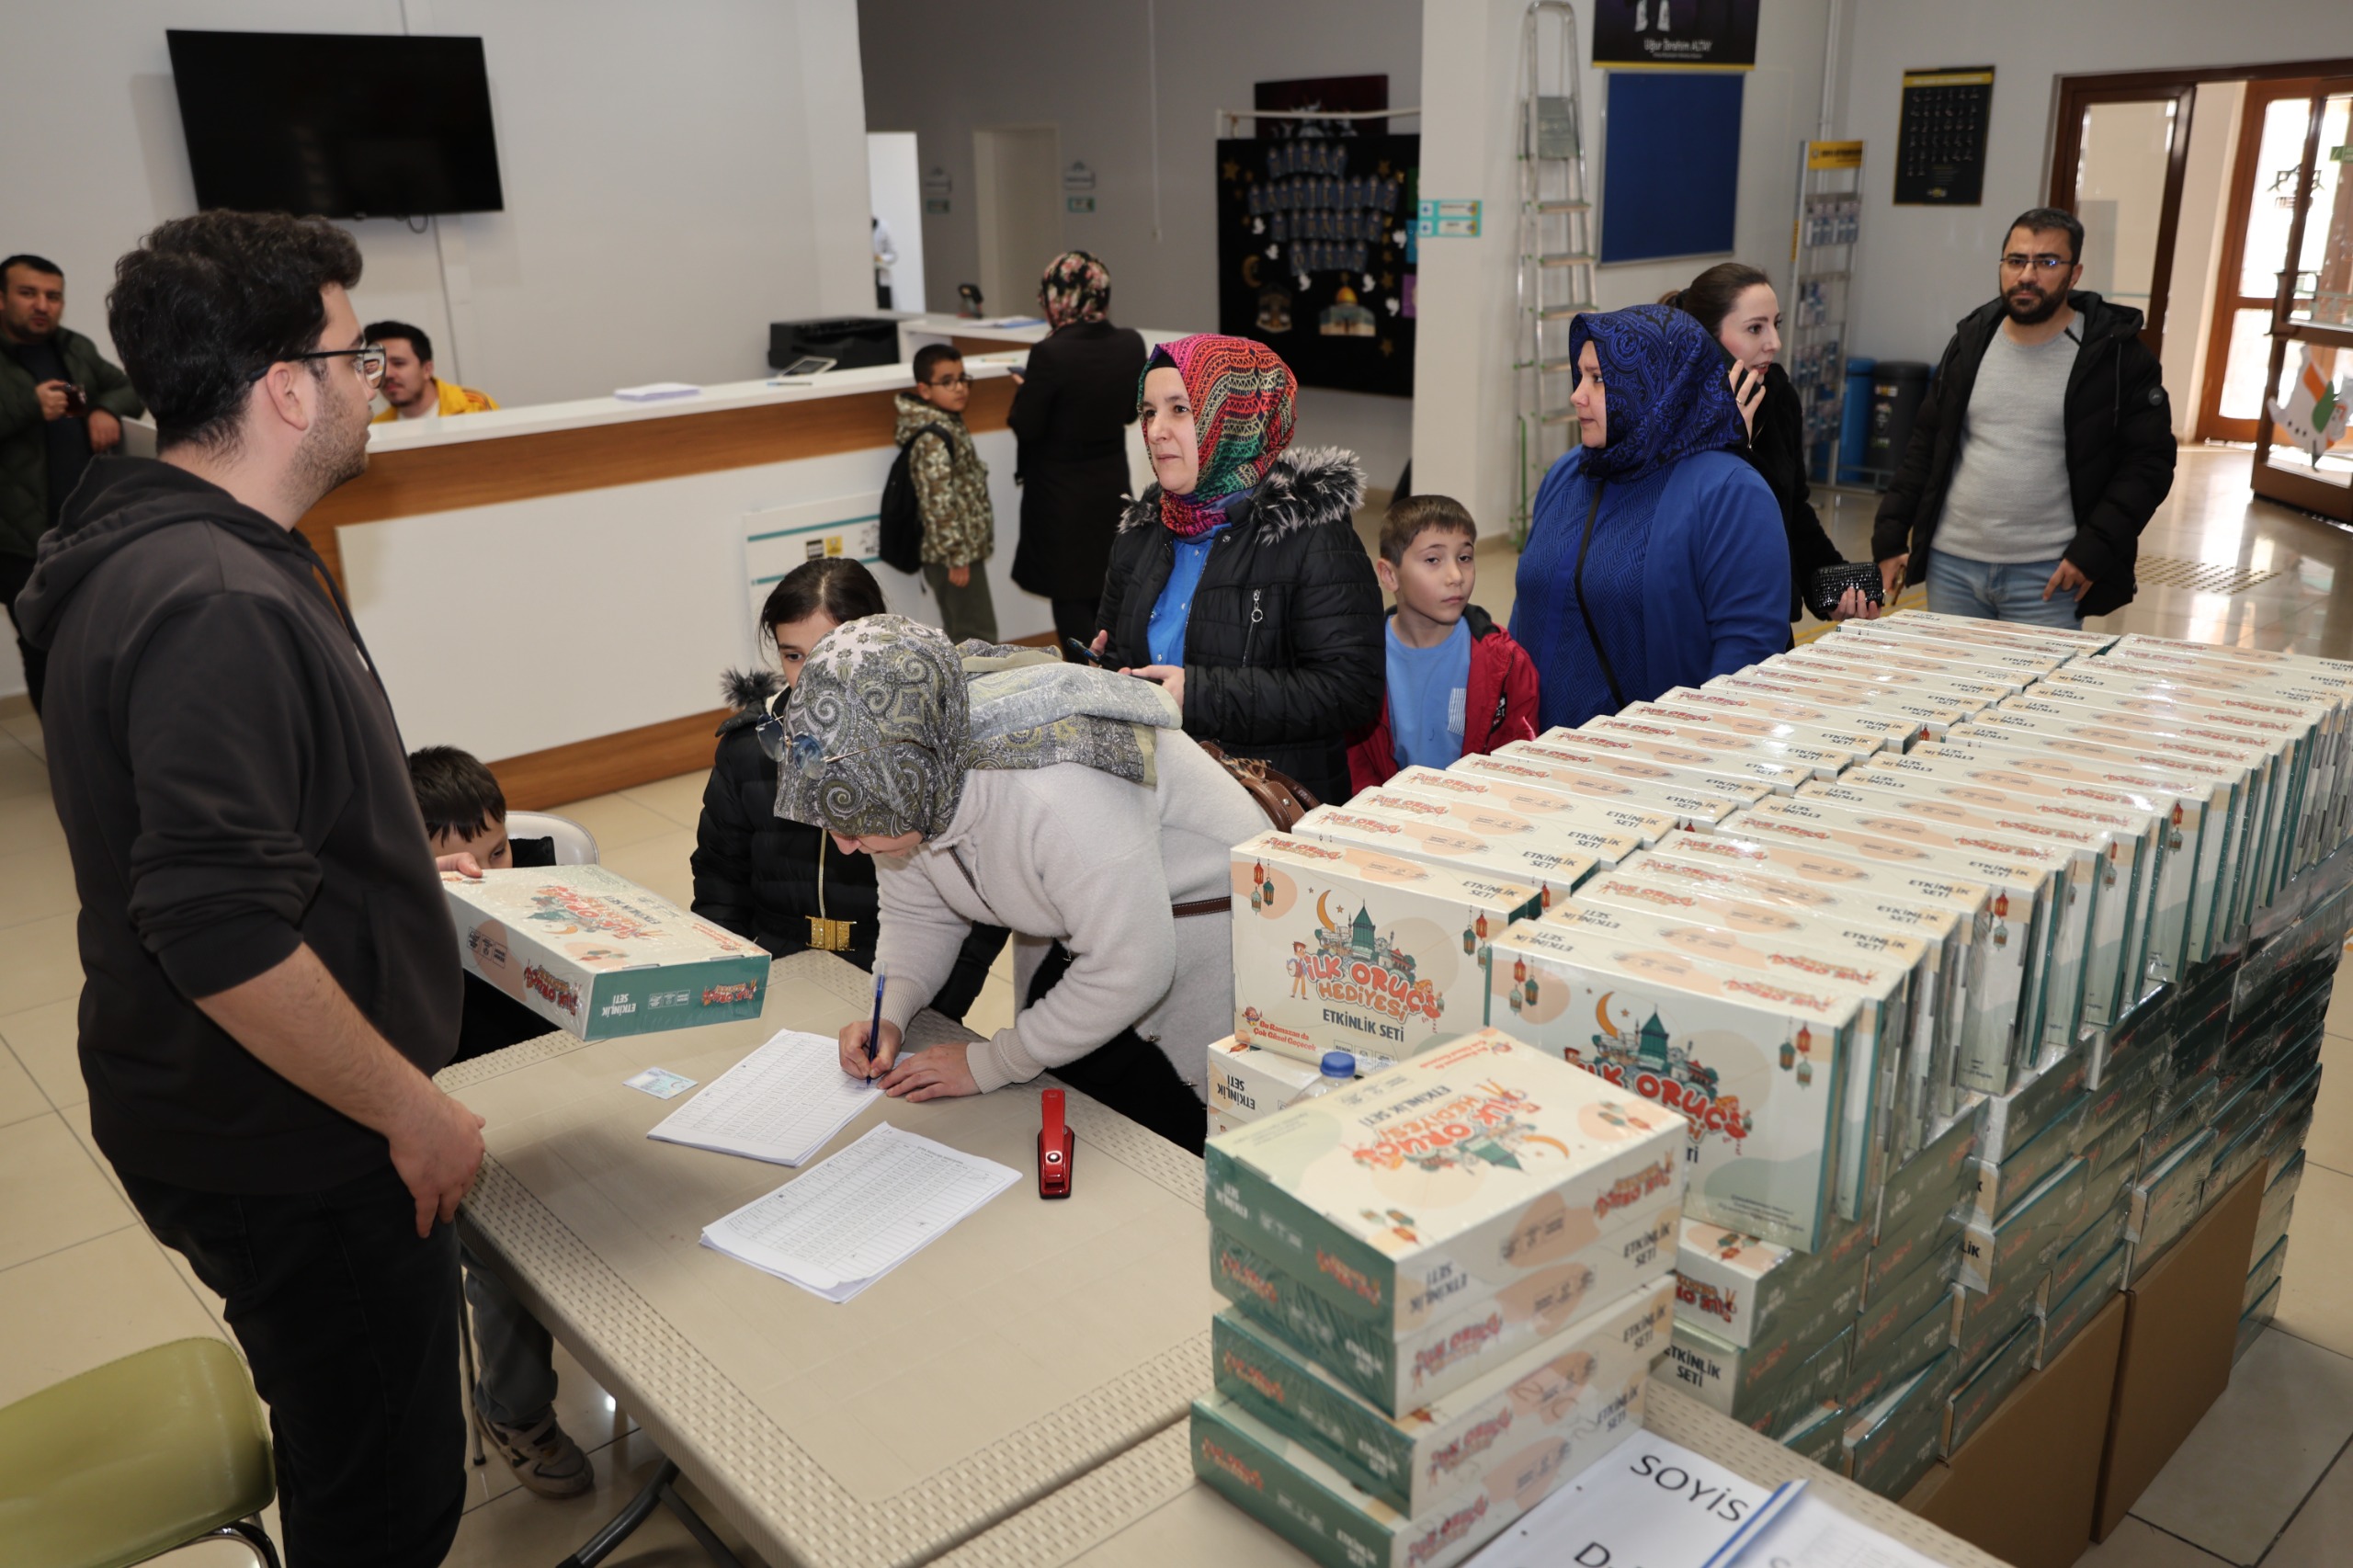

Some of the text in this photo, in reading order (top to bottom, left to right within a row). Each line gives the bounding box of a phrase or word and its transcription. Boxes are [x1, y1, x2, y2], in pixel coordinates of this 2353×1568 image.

[602, 1003, 637, 1017] ETKİNLİK
[612, 994, 630, 1005] SETİ
[1318, 982, 1409, 1022] HEDİYESİ
[1259, 1020, 1310, 1040] Bu Ramazan da
[1323, 1008, 1404, 1042] ETKİNLİK SETİ
[1253, 1028, 1317, 1051] Çok Güzel Geçecek
[1226, 1074, 1245, 1091] SETİ
[1218, 1083, 1256, 1110] ETKİNLİK
[1676, 1365, 1702, 1388] SETİ
